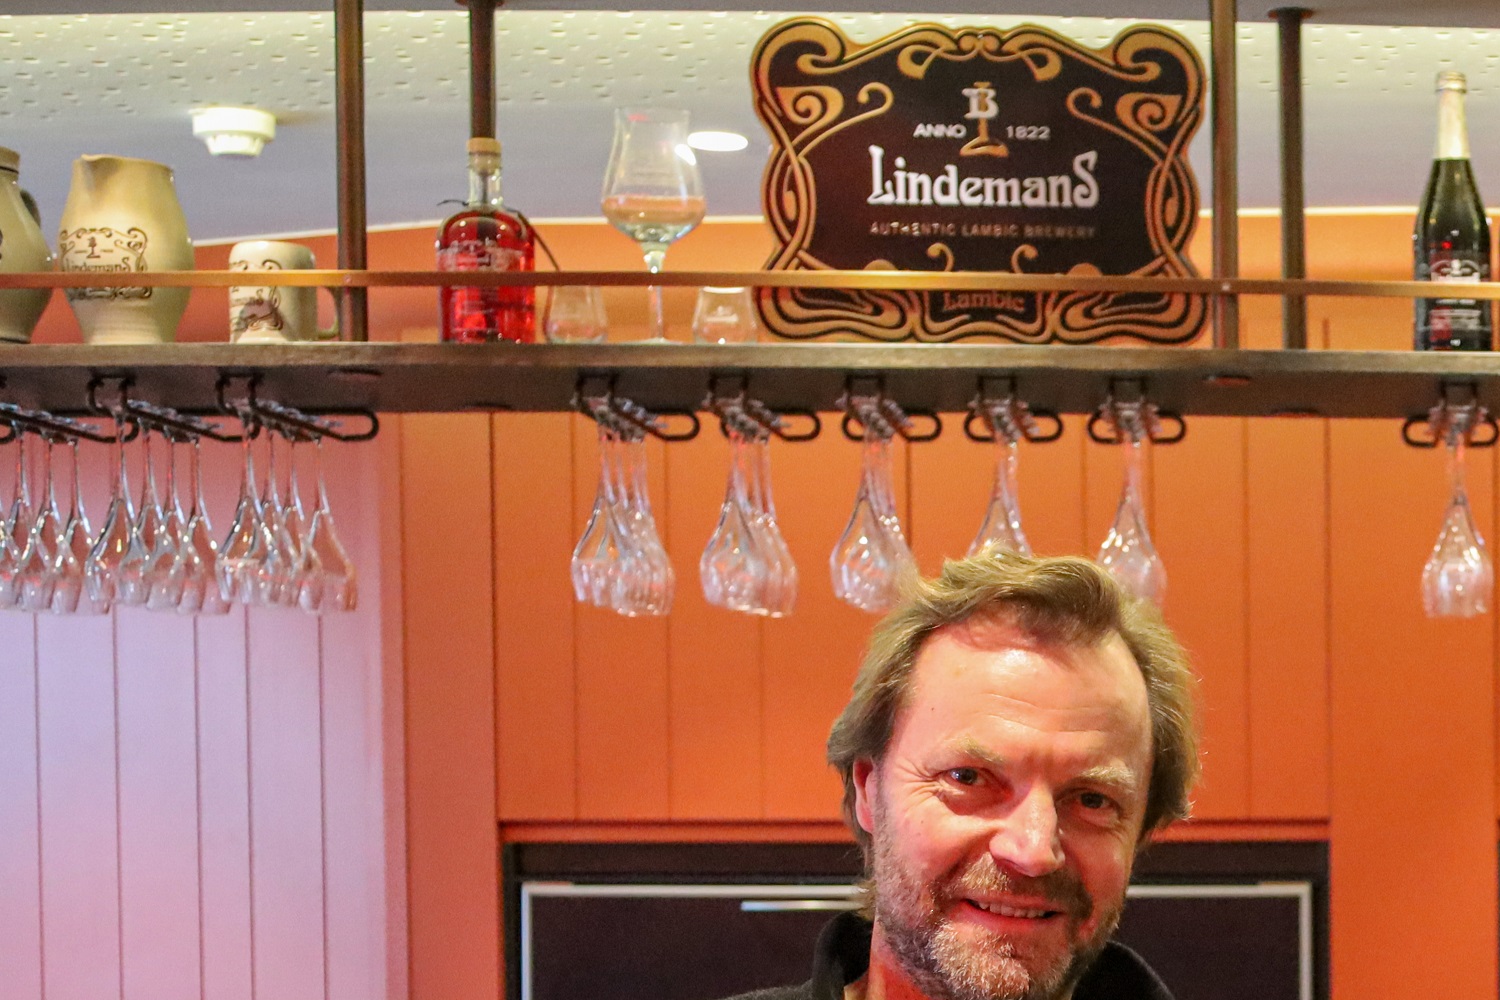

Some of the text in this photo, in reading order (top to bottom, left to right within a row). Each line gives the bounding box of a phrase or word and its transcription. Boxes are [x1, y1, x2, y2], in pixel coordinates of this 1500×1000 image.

[913, 122, 1051, 140] ANNO 1822
[866, 144, 1099, 208] LindemanS
[870, 221, 1097, 238] AUTHENTIC LAMBIC BREWERY
